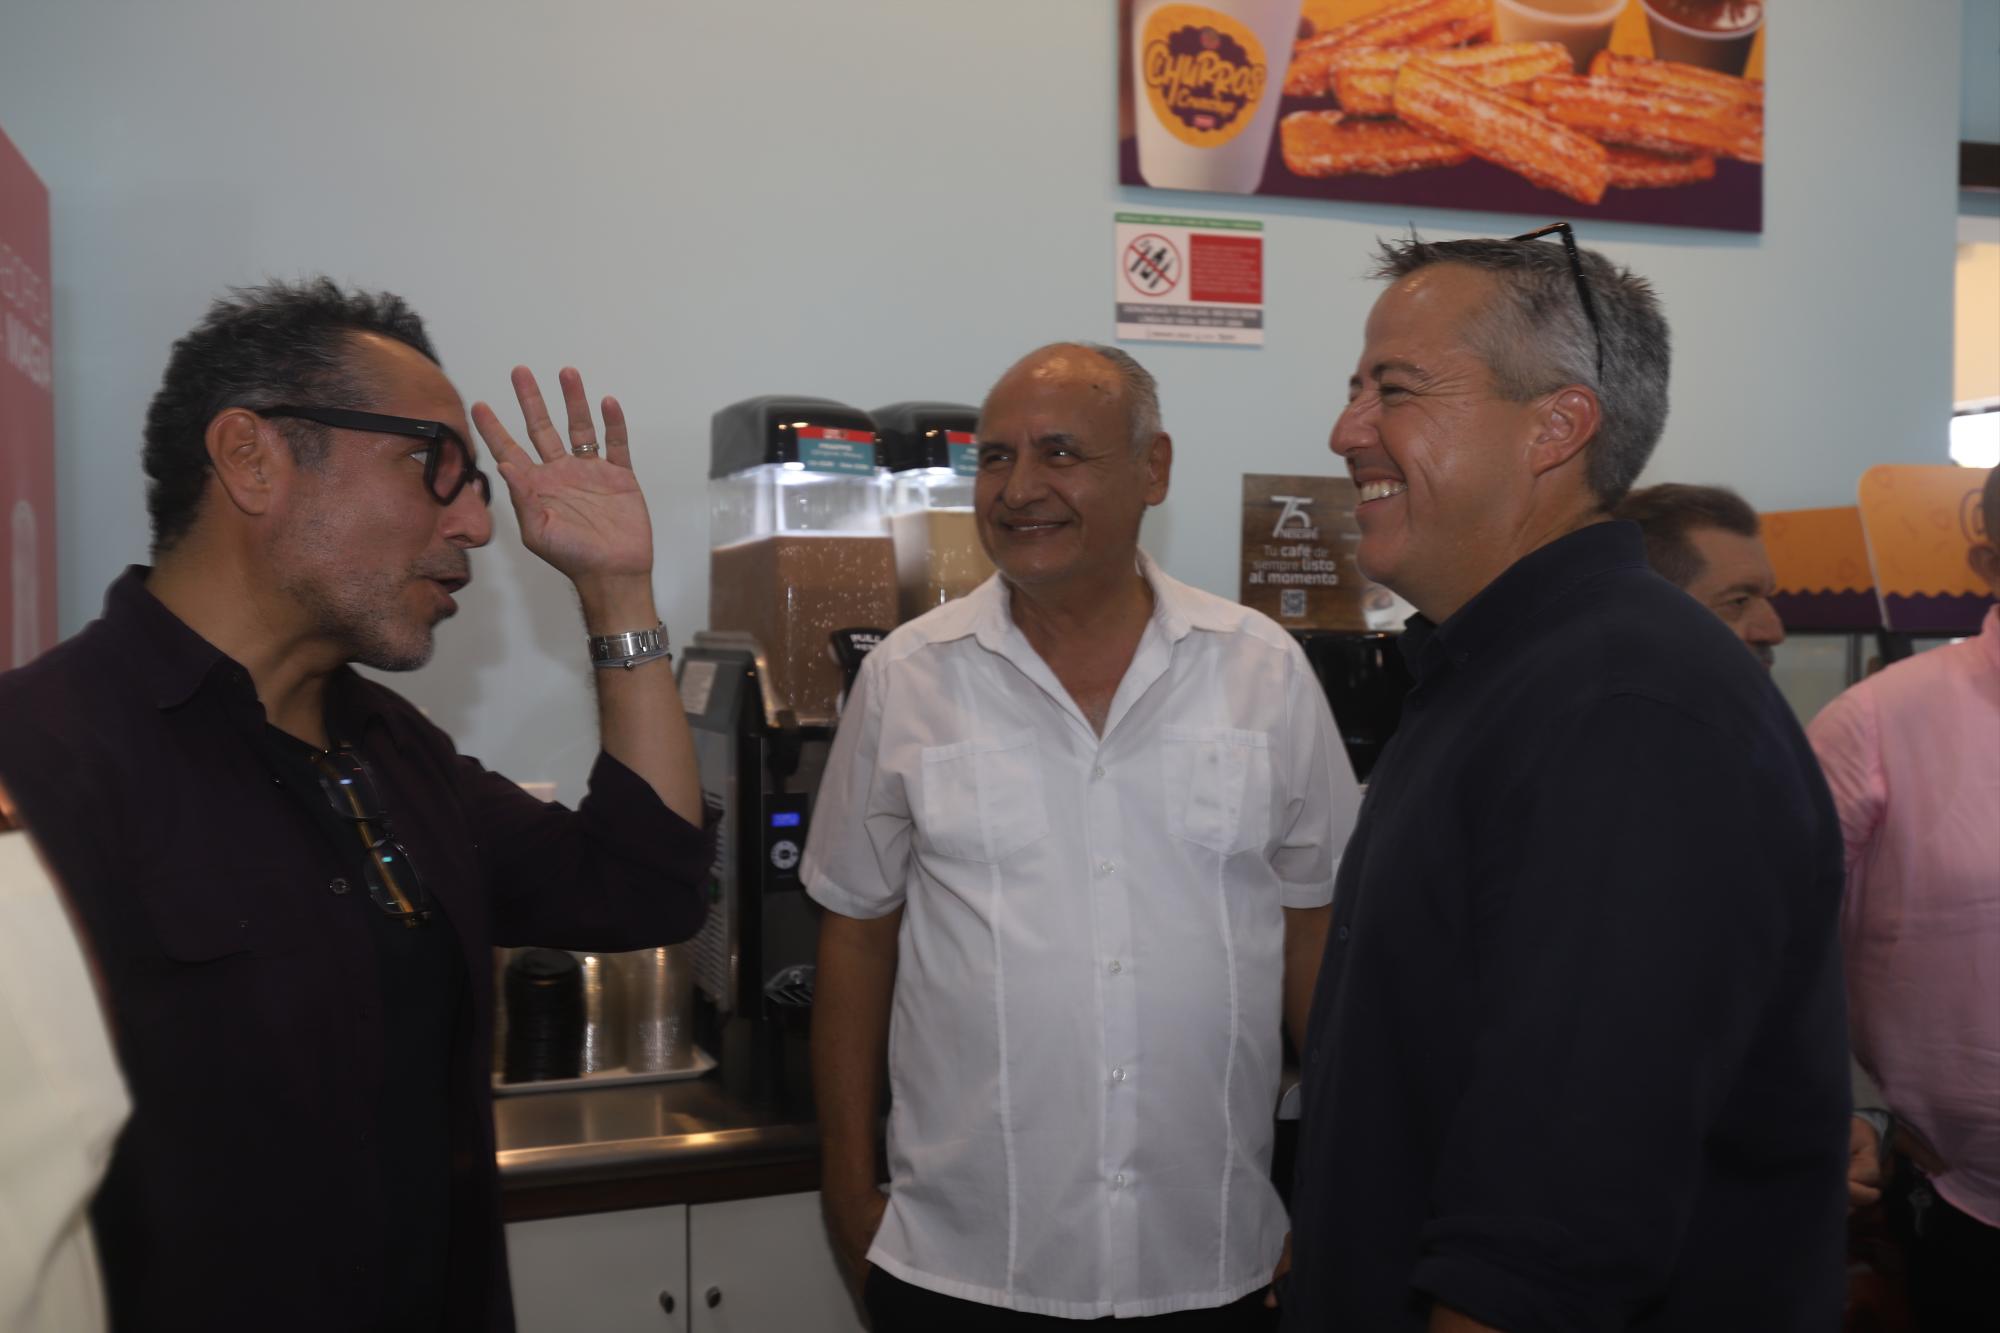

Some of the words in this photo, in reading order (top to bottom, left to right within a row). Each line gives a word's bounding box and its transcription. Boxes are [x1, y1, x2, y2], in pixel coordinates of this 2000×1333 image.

[1263, 544, 1278, 556] Tu
[1313, 546, 1328, 557] de
[1248, 570, 1265, 583] al
[1267, 571, 1338, 585] momento
